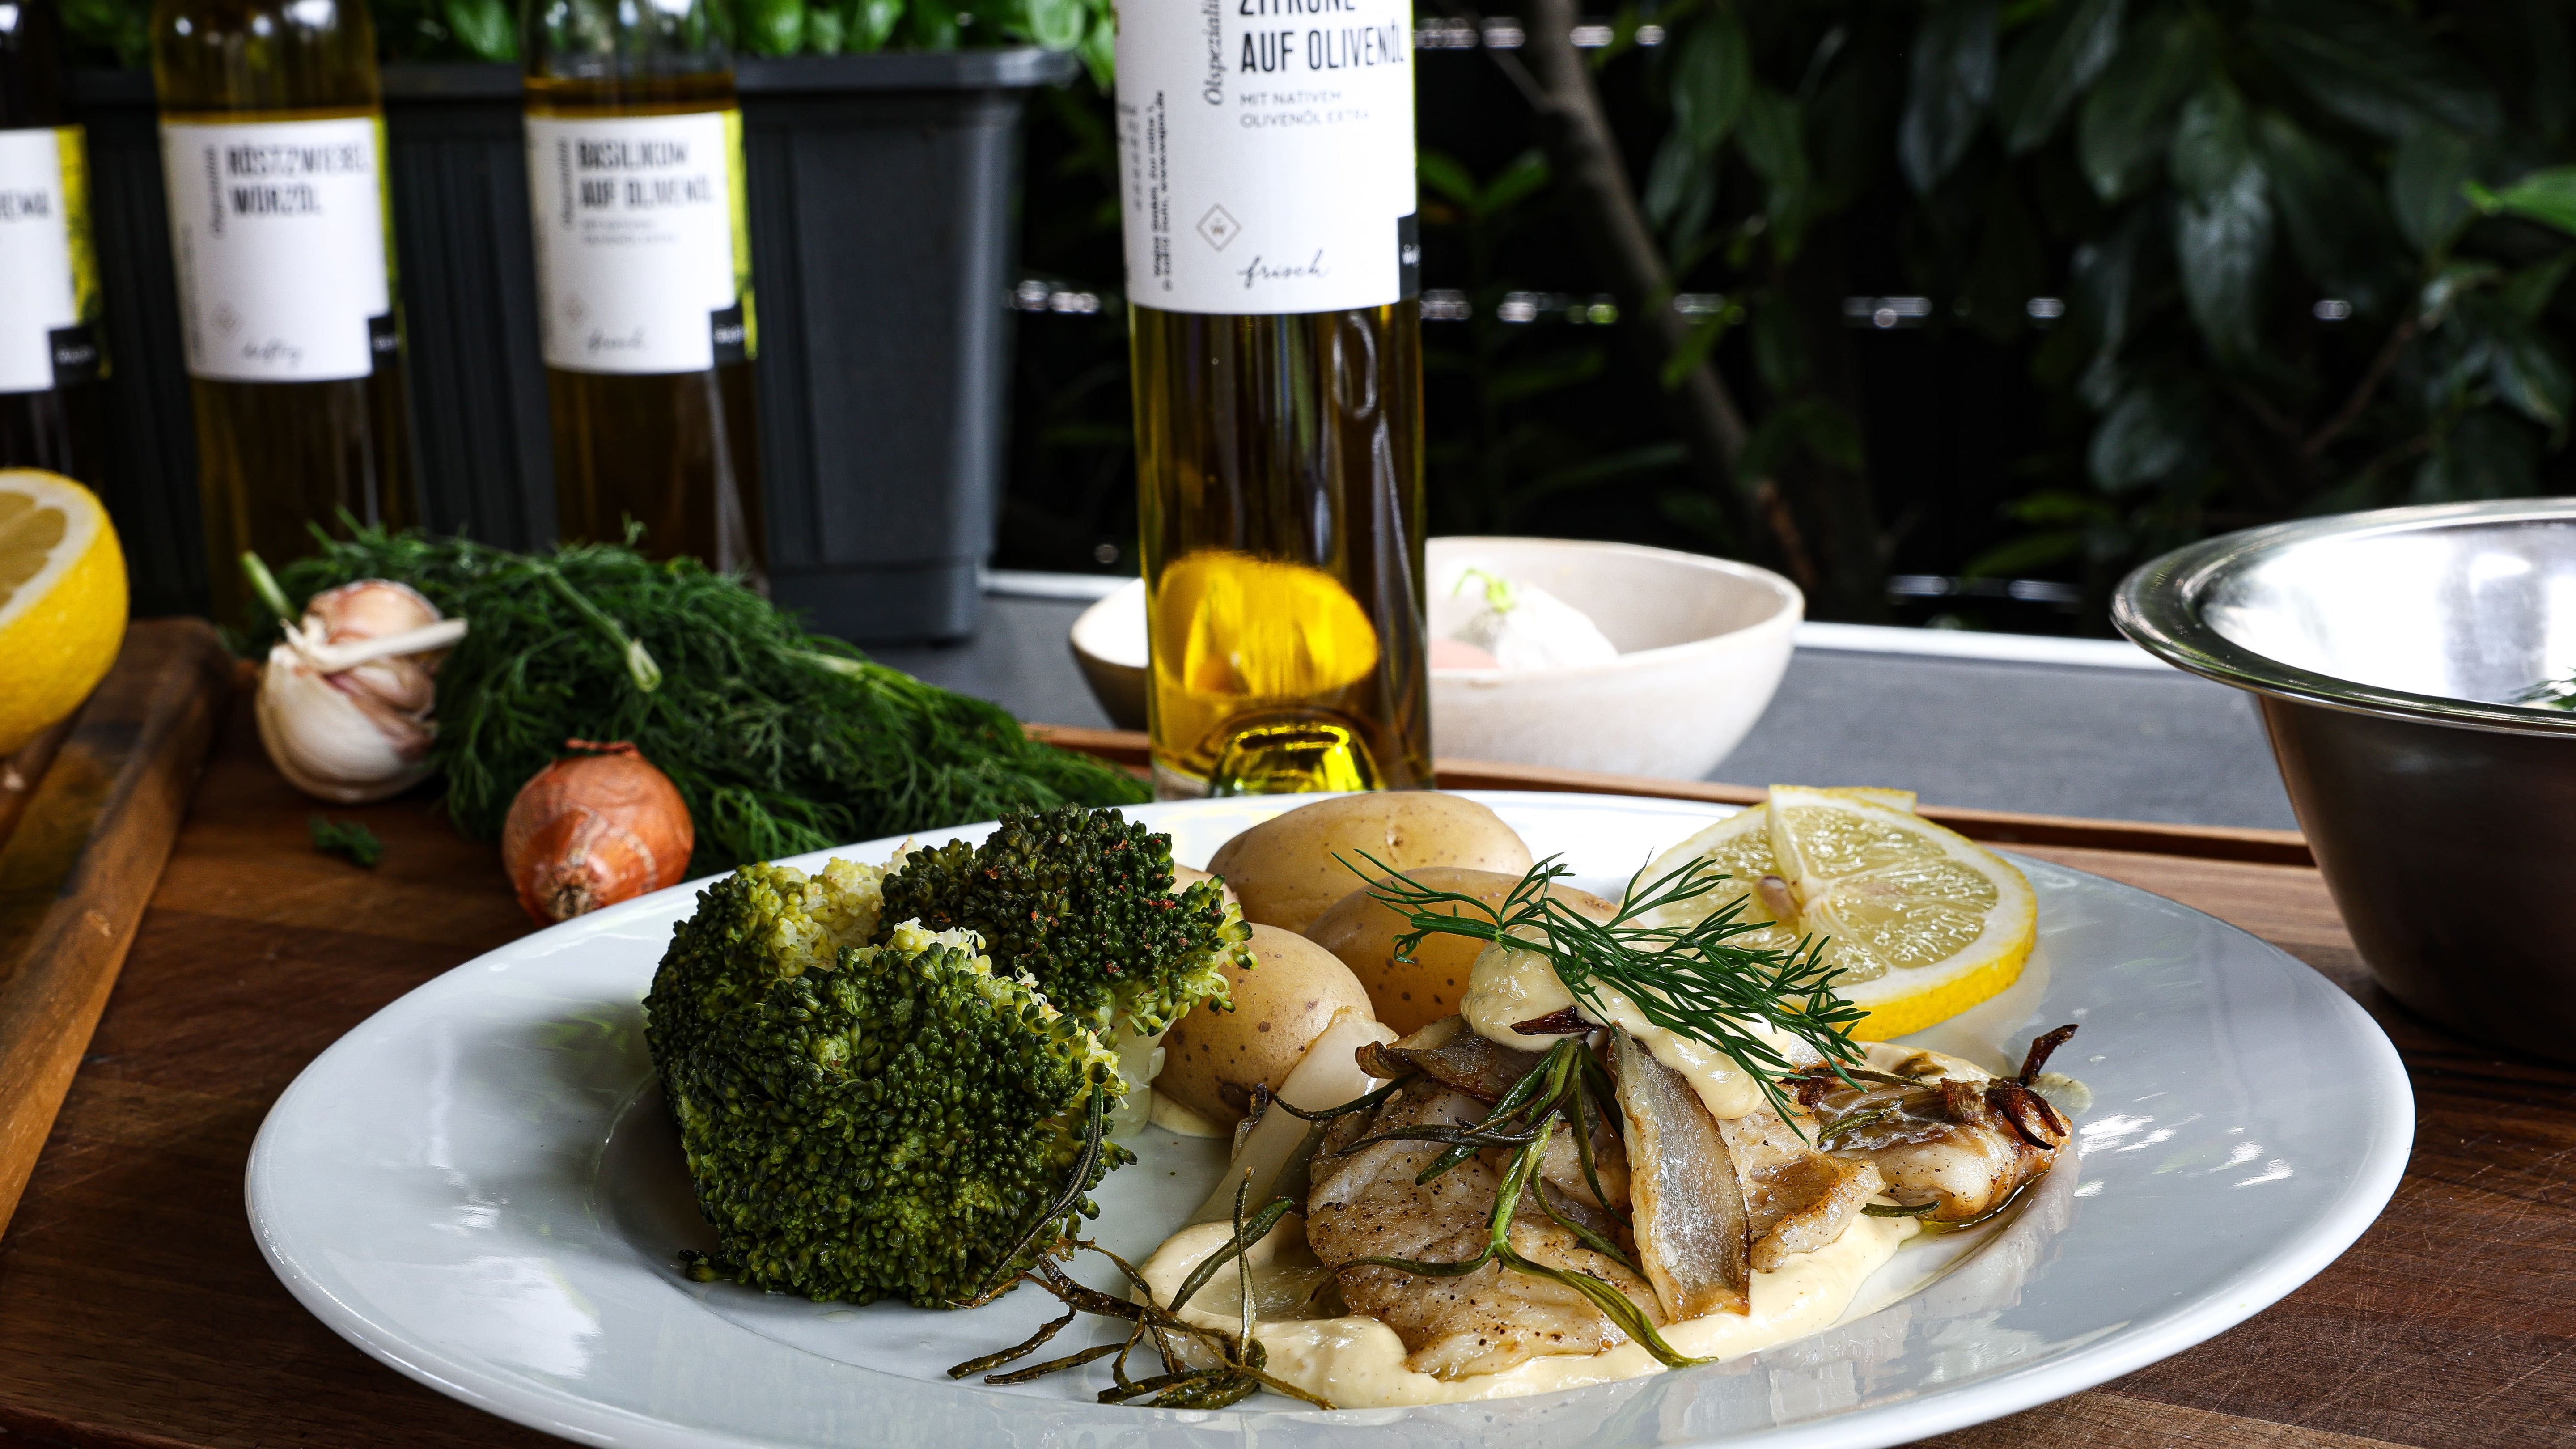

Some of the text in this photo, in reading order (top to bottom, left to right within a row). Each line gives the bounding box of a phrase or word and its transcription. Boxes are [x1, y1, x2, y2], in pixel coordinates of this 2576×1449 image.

[1202, 0, 1226, 106] Ölspeziali
[1241, 19, 1404, 72] AUF OLIVENÖL
[1240, 91, 1267, 106] MIT
[1237, 247, 1331, 288] frisch
